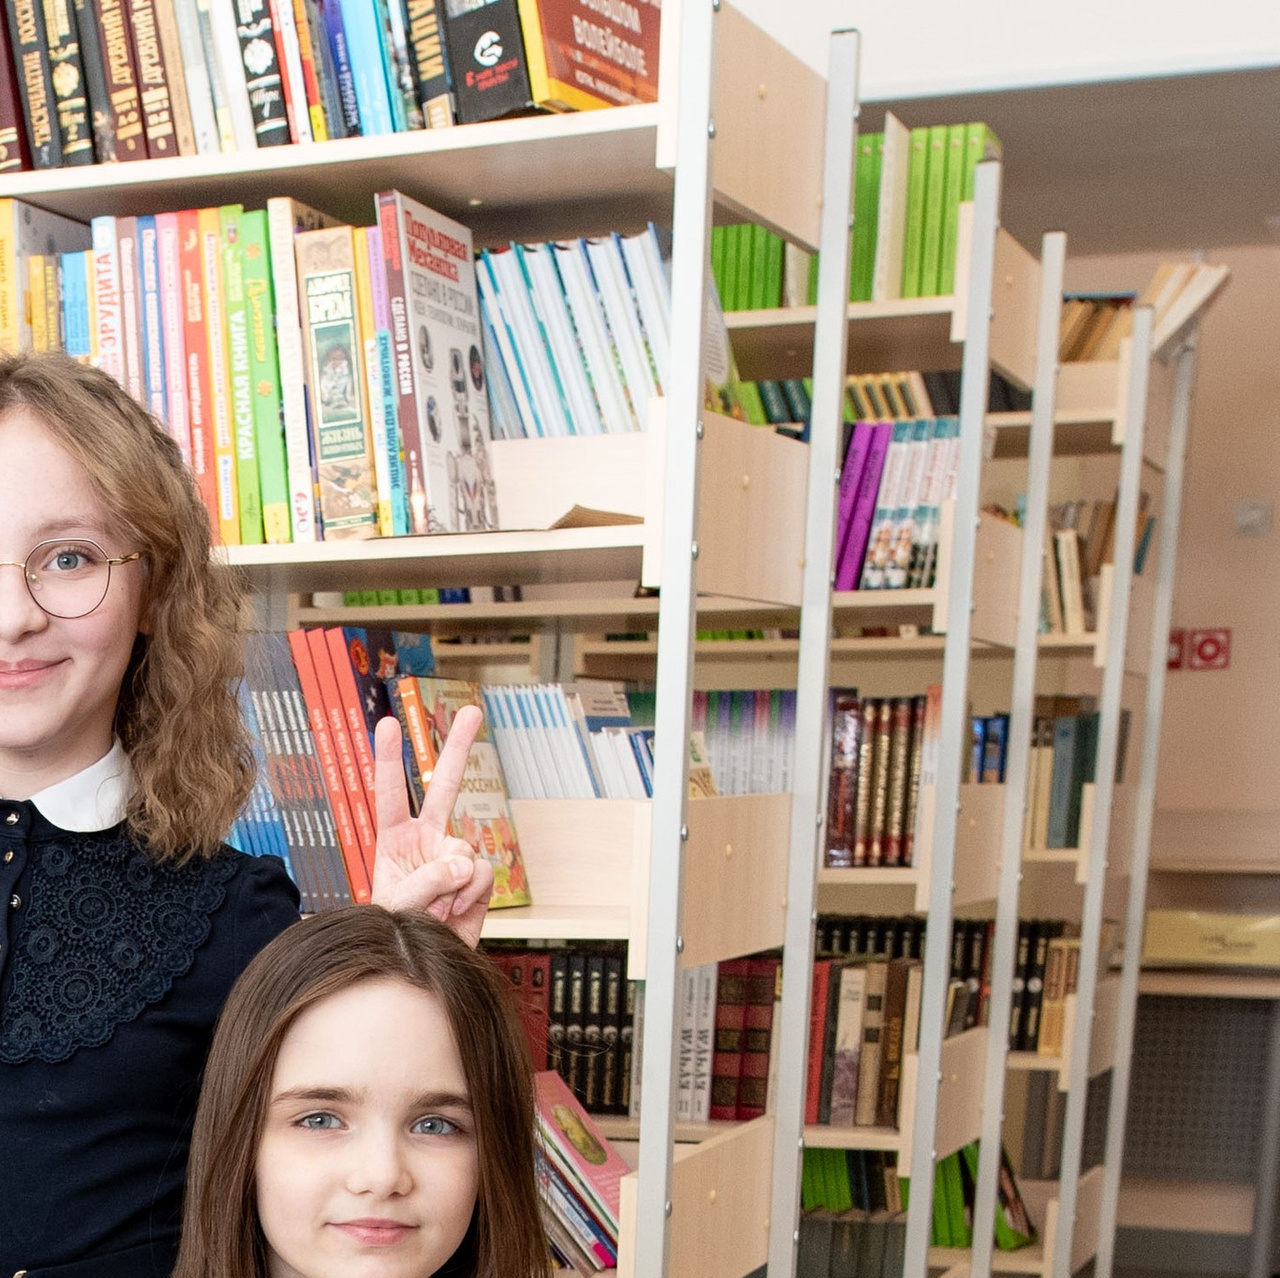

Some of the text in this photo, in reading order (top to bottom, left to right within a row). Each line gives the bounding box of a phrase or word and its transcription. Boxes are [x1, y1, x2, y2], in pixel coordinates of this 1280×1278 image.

[101, 9, 133, 84] ДРЕВНИЙ
[131, 8, 165, 84] ДРЕВНИЙ
[22, 51, 51, 147] ТЫСЯЧЕЛЕТИЕ
[96, 251, 117, 349] ЭРУДИТА
[246, 278, 267, 363] Динозавры
[231, 309, 255, 461] КРАСНАЯ КНИГА
[390, 296, 412, 396] СДЕЛАНО В РОССИИ
[188, 352, 205, 475] БОЛЬШОЙ ОПРЕДЕЛИТЕЛЬ
[379, 335, 402, 489] ЭНЦИКЛОПЕДИЯ ЖИВОТНЫХ
[407, 704, 427, 753] МИХАЛКОВ
[679, 1029, 693, 1091] КУЧУМ
[694, 1028, 709, 1091] КУЧУМ
